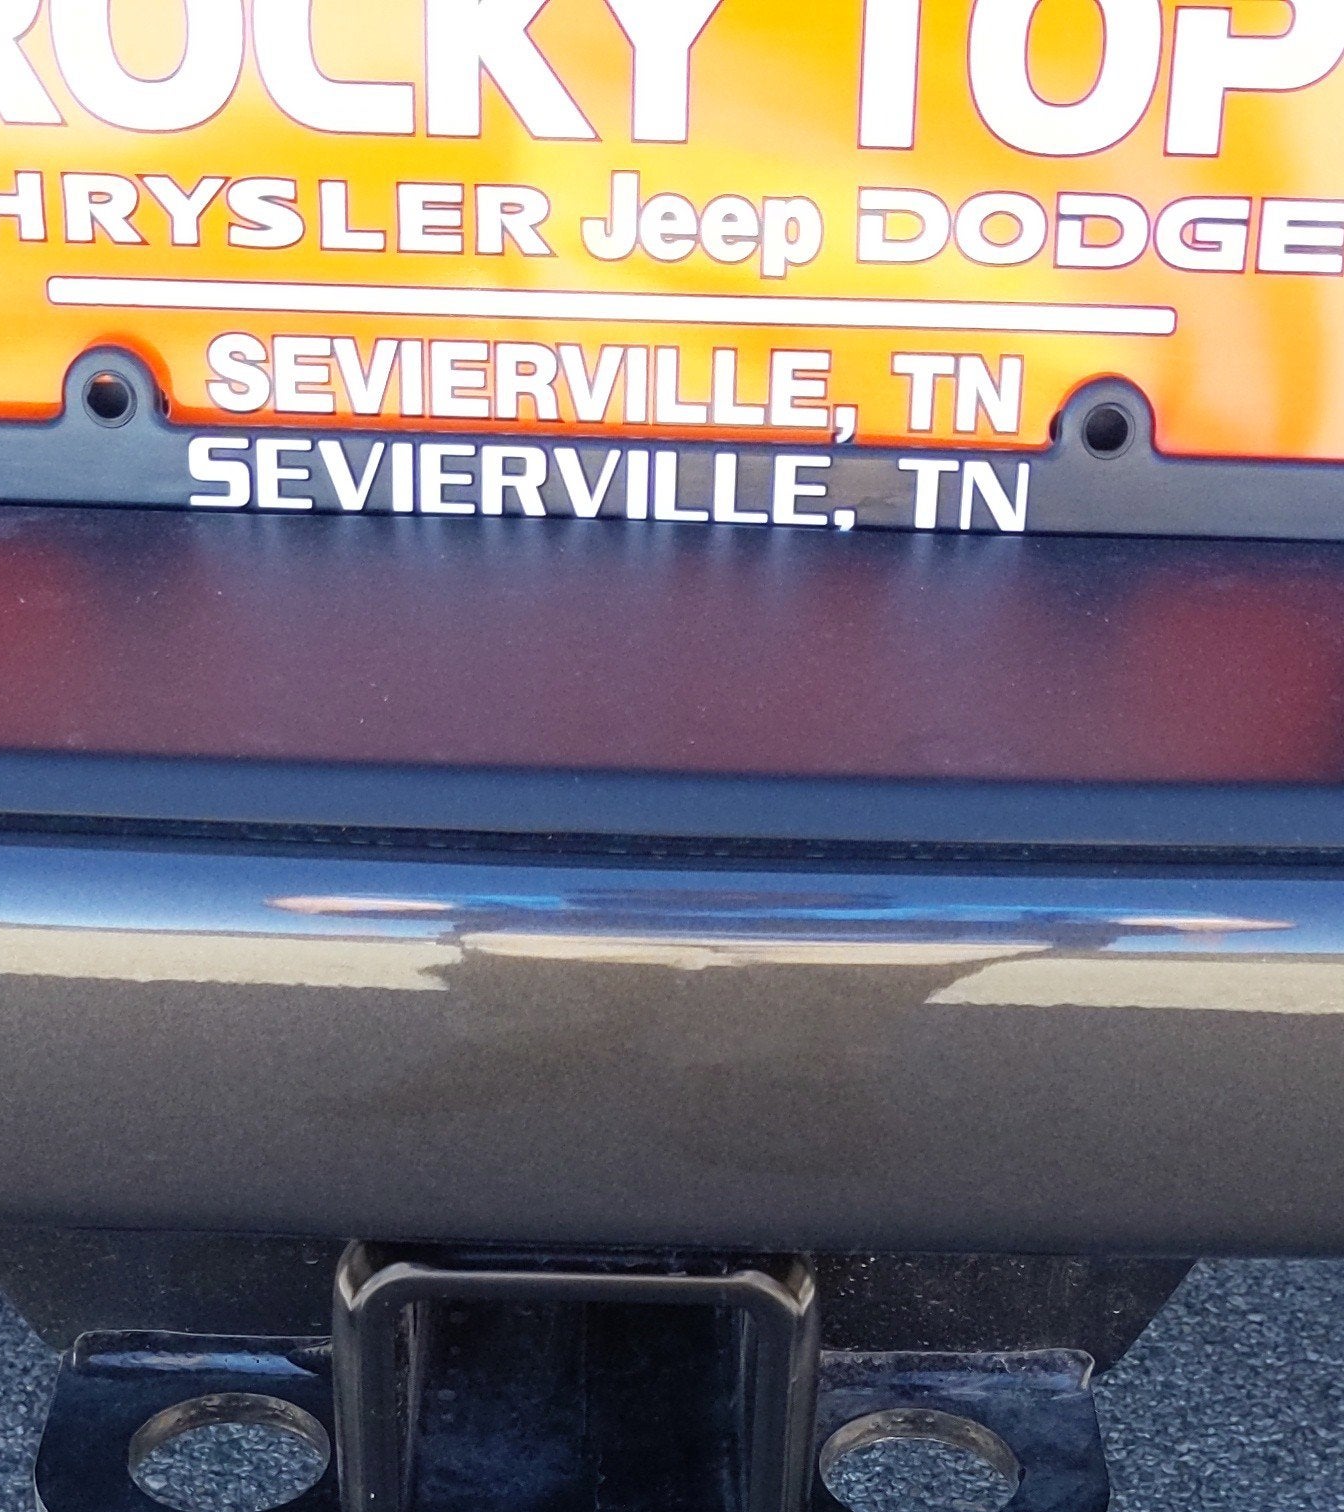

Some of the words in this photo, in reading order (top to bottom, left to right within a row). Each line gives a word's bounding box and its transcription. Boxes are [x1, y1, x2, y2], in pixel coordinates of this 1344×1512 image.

[581, 169, 823, 280] Jeep
[205, 331, 858, 445] SEVIERVILLE,
[891, 351, 1025, 436] TN
[188, 436, 856, 533] SEVIERVILLE,
[898, 458, 1031, 533] TN
